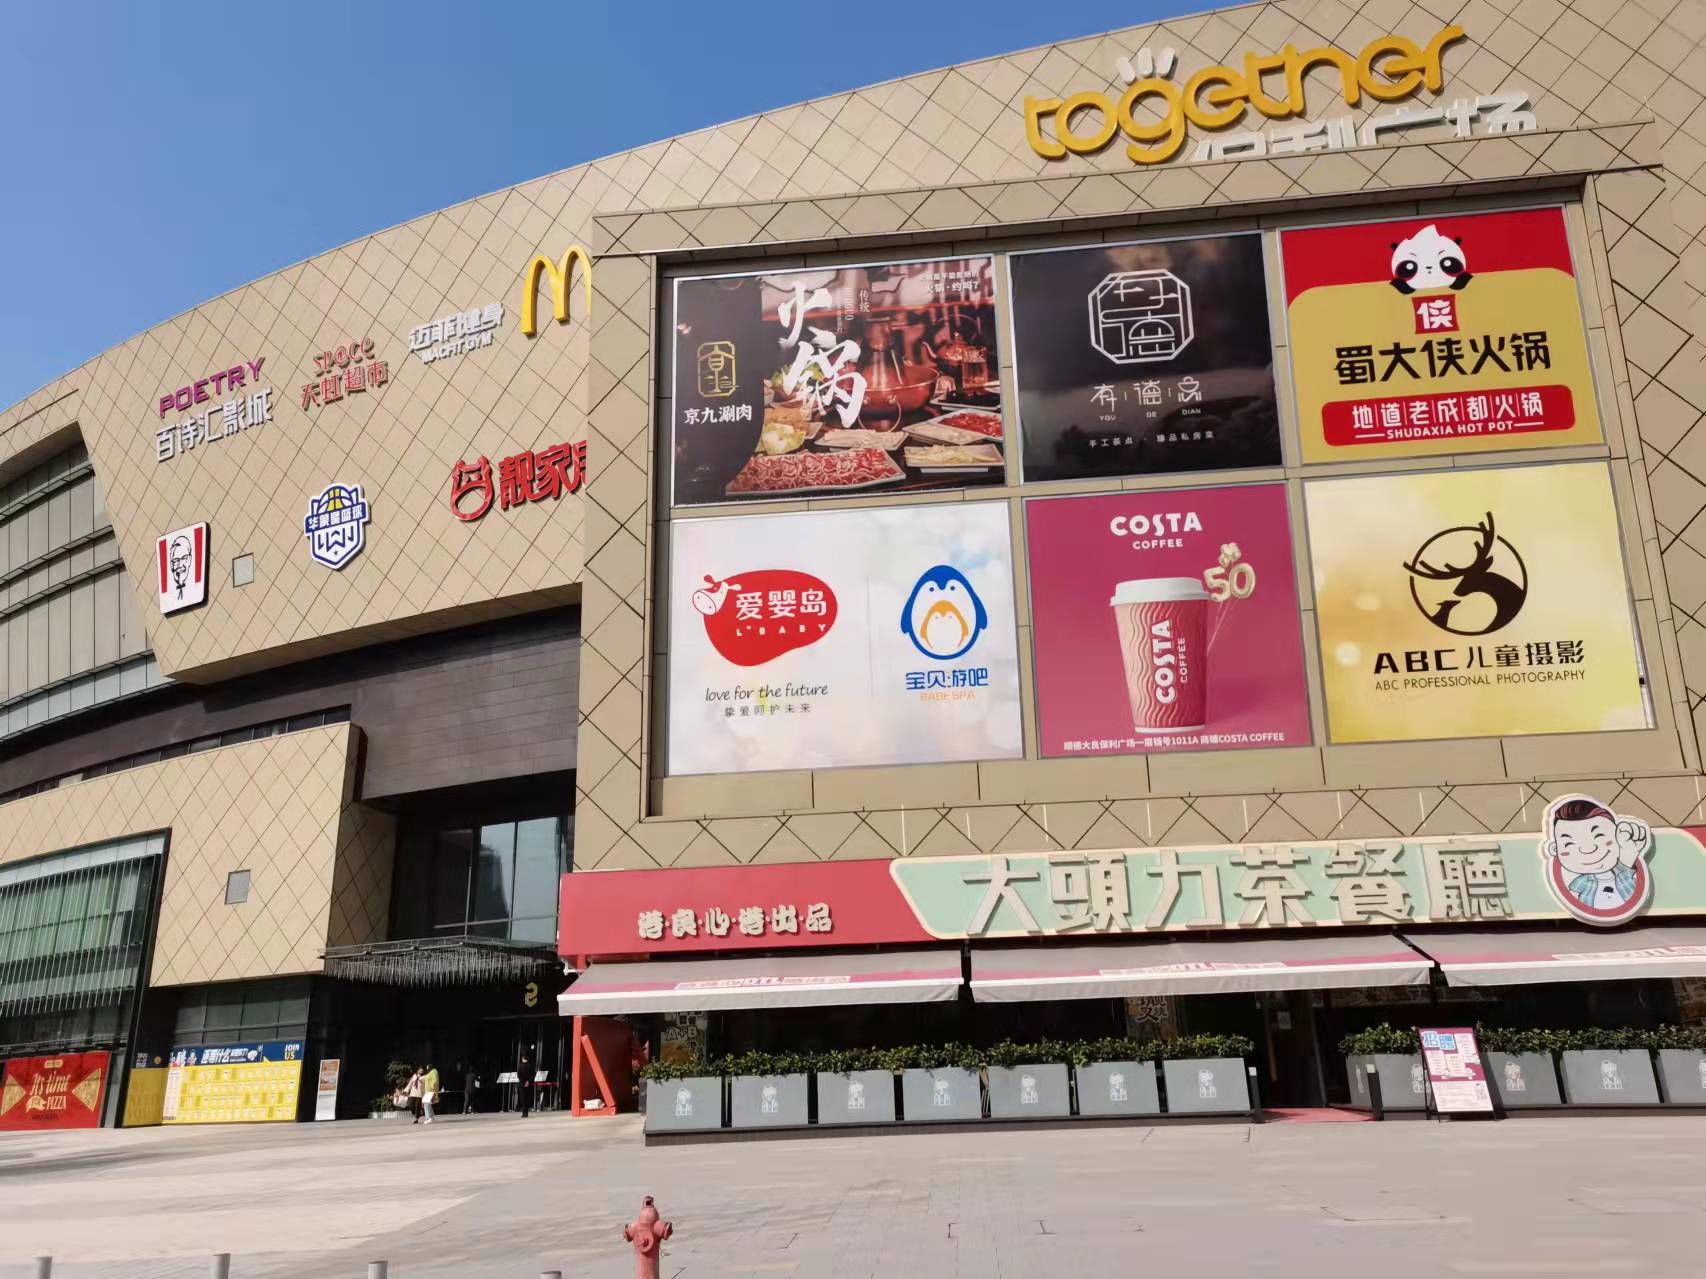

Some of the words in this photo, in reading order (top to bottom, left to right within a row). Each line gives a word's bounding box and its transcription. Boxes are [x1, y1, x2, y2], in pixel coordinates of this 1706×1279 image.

[1024, 26, 1464, 165] together
[466, 330, 493, 351] GYM
[1334, 331, 1551, 385] 蜀大侠火锅
[159, 357, 265, 419] POETRY
[300, 361, 388, 411] 天虹超市
[155, 386, 273, 462] 百诗汇影城
[683, 403, 753, 425] 京九涮肉
[1352, 392, 1544, 429] 地道老成都火锅
[1386, 427, 1454, 440] SHUDAXIA
[1457, 422, 1484, 434] HOT
[1488, 420, 1514, 432] POT
[1110, 512, 1203, 537] COSTA
[1132, 538, 1184, 550] COFFEE
[1203, 562, 1257, 602] 50
[735, 588, 827, 621] 爱婴岛
[1150, 619, 1177, 704] COSTA
[1177, 637, 1189, 684] COFFEE
[1373, 640, 1585, 674] ABC儿童摄影
[705, 687, 731, 702] love
[734, 685, 755, 700] for
[759, 684, 782, 699] the
[785, 682, 829, 697] future
[1375, 679, 1399, 691] ABC
[1403, 674, 1491, 689] PROFESSIONAL
[1496, 669, 1586, 684] PHOTOGRAPHY
[1249, 732, 1285, 742] COFFEE
[46, 1096, 67, 1110] PIZZA
